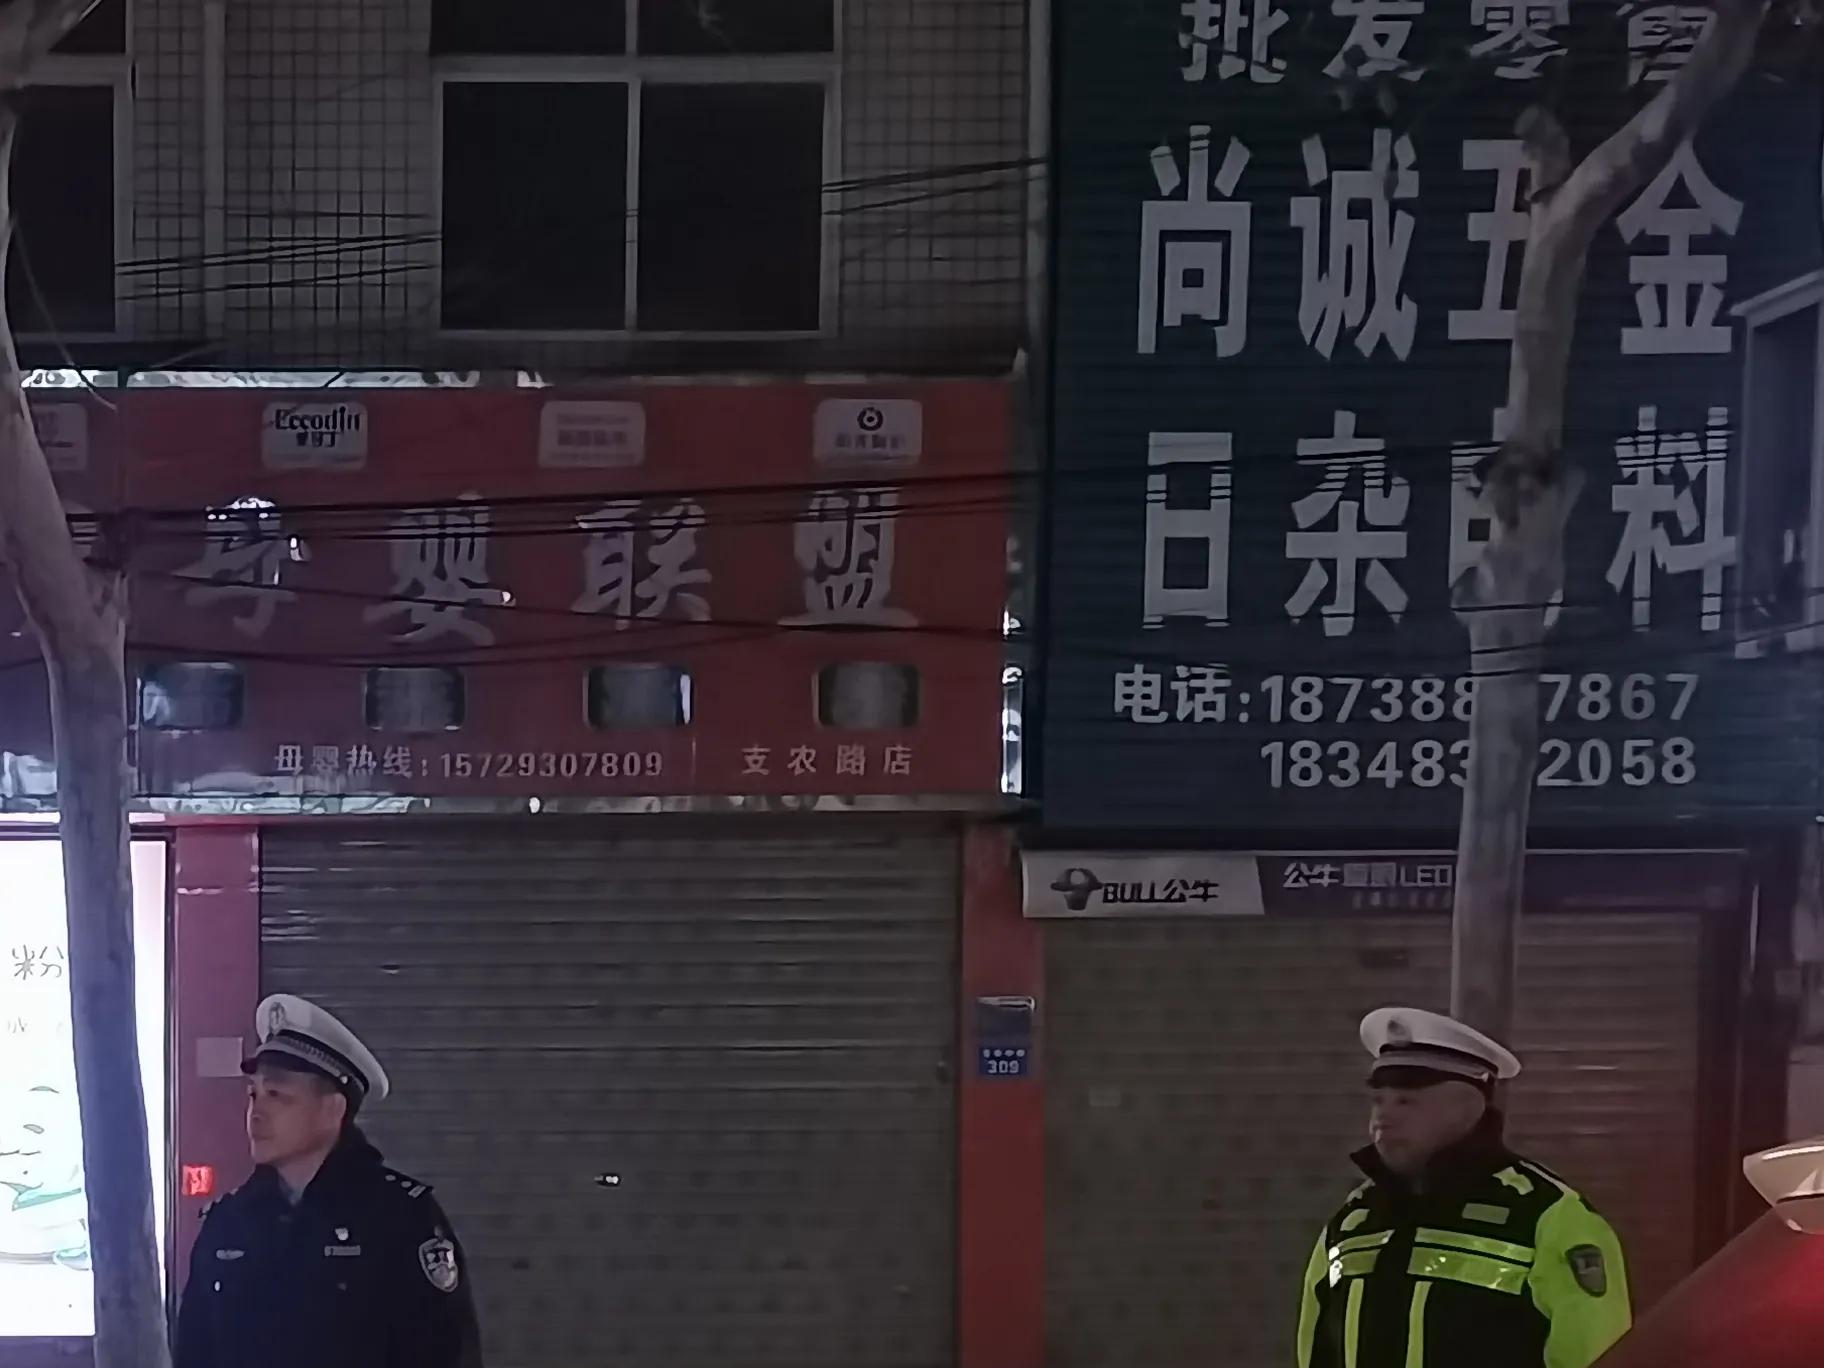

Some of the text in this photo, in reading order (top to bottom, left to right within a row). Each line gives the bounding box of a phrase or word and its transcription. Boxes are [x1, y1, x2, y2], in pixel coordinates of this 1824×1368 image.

[1138, 125, 1744, 362] 尚诚五金
[1113, 663, 1699, 724] 电话:1873887867
[742, 746, 912, 776] 支农路店
[1259, 737, 1696, 789] 1834832058
